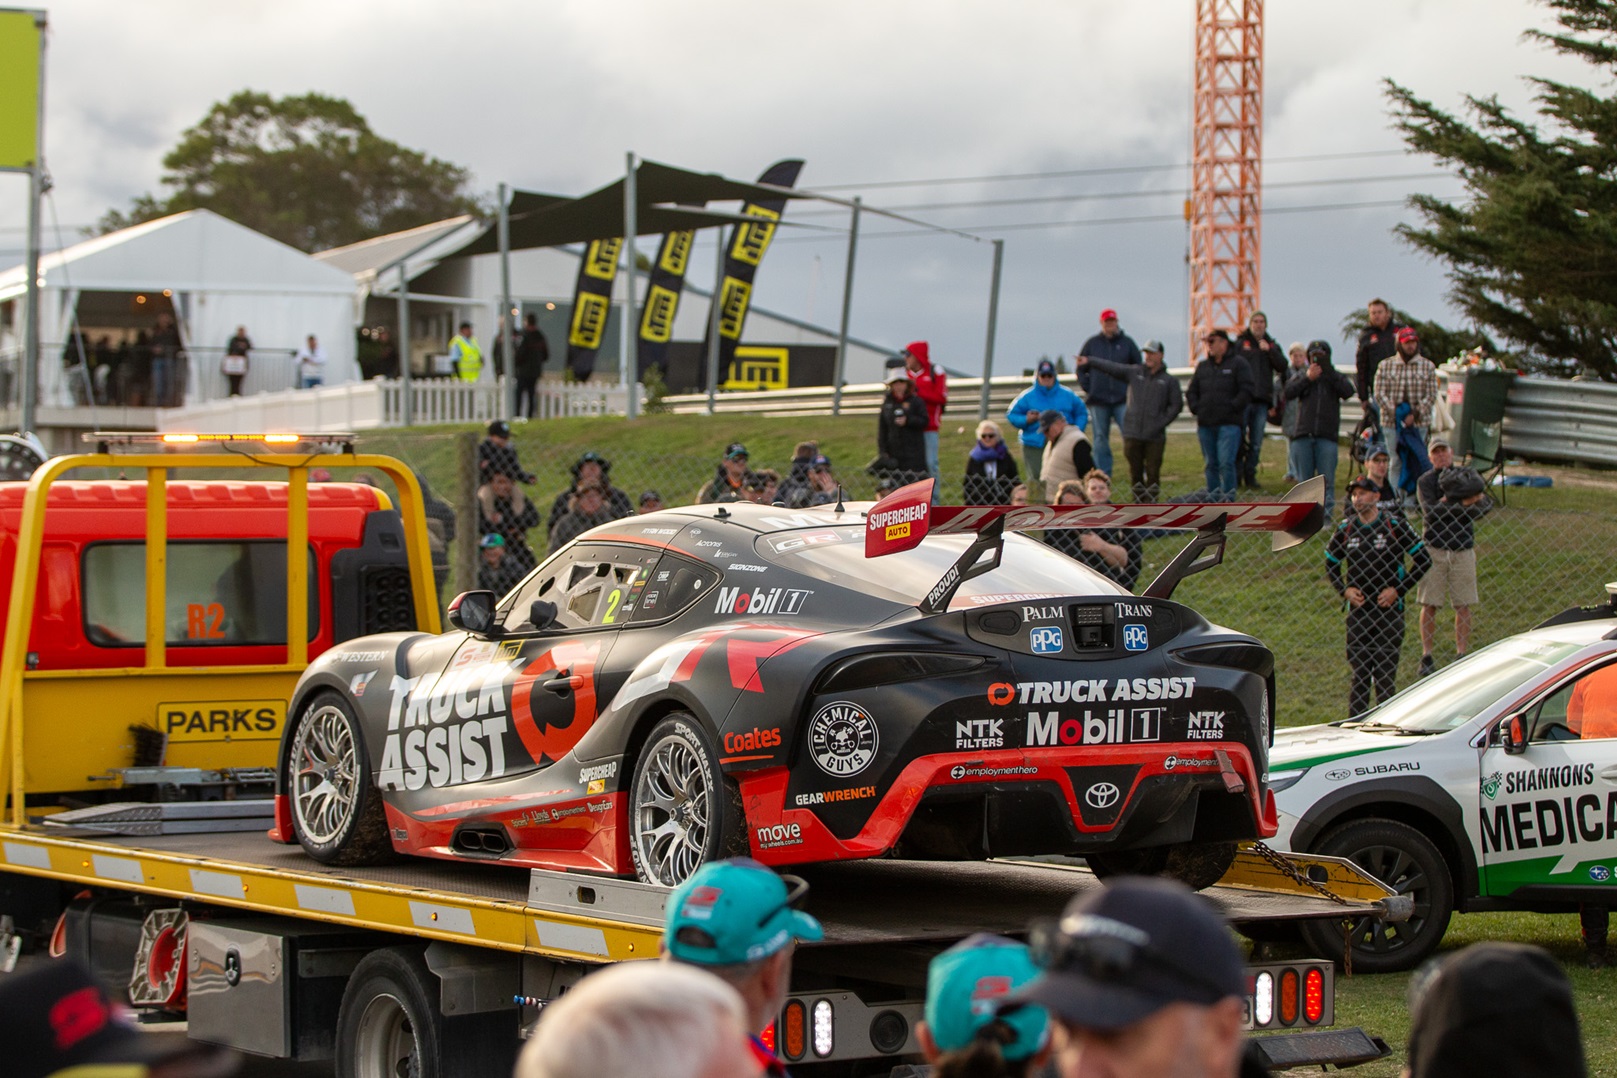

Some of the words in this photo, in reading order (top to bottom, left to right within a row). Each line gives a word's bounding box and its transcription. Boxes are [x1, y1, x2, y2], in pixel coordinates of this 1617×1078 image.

[870, 503, 928, 530] SUPERCHEAP
[888, 526, 908, 538] AUTO
[602, 589, 621, 624] 2
[714, 587, 782, 615] Mobil
[1022, 605, 1064, 623] PALM
[1115, 602, 1153, 618] TRANS
[187, 603, 226, 639] R2
[1032, 629, 1061, 651] PPG
[1125, 627, 1148, 648] PPG
[387, 656, 528, 731] TRUCK
[1017, 679, 1108, 704] TRUCK
[1111, 676, 1197, 702] ASSIST
[167, 708, 277, 734] PARKS
[813, 707, 873, 743] CHEMICAL
[956, 718, 1004, 738] NTK
[1026, 709, 1125, 746] Mobil
[1188, 711, 1226, 729] NTK
[724, 727, 782, 754] Coates
[956, 737, 1004, 749] FILTERS
[1187, 729, 1224, 739] FILTERS
[378, 715, 508, 792] ASSIST
[826, 753, 864, 772] GUYS
[578, 761, 617, 785] SUPERCHEAP
[1355, 761, 1421, 776] SUBARU
[1505, 762, 1595, 795] SHANNONS
[795, 785, 877, 806] GEARWRENCH
[757, 822, 801, 843] move
